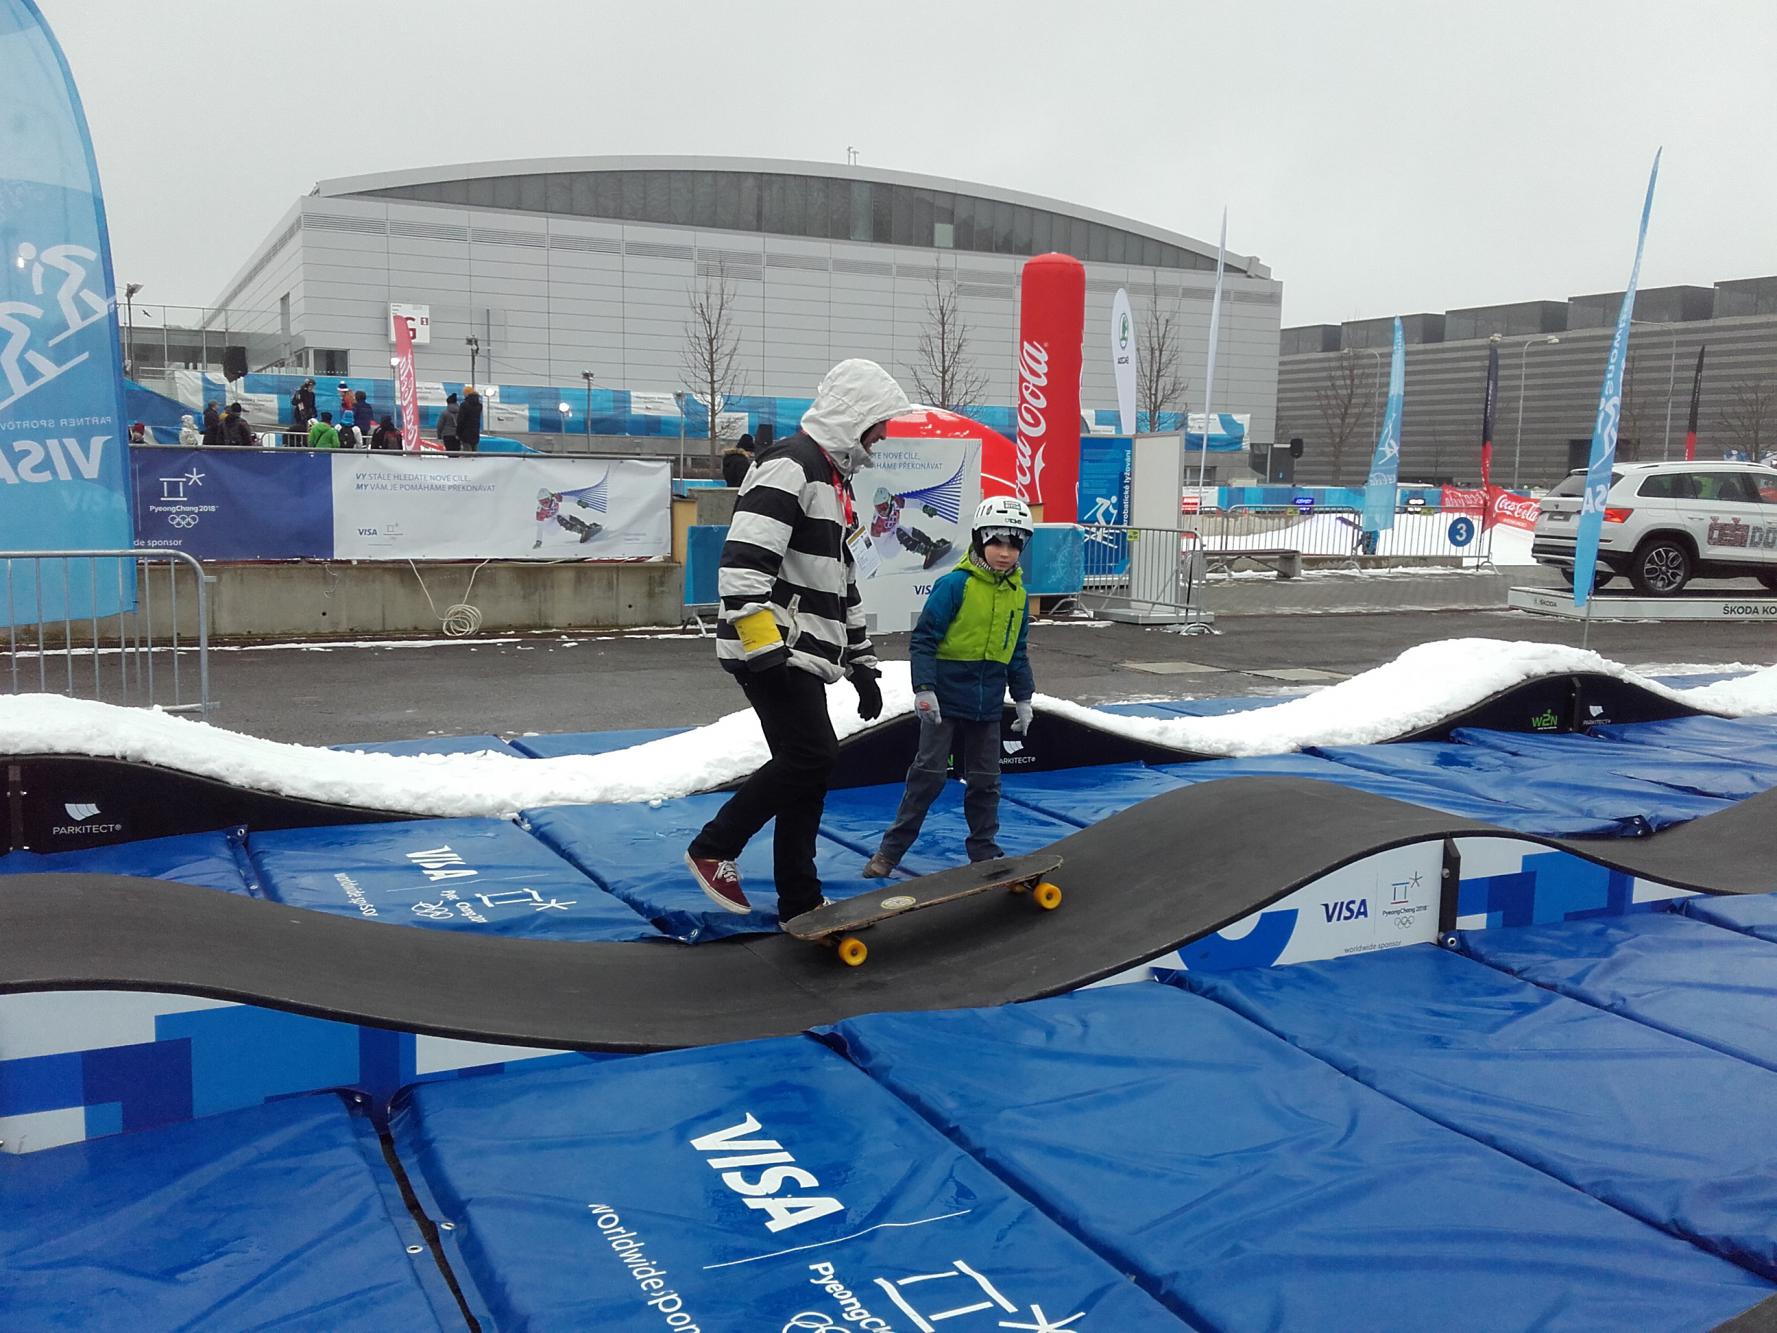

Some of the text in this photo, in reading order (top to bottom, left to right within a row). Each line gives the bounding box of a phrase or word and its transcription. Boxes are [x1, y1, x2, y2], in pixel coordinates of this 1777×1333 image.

[1016, 340, 1049, 503] oca-Cola
[355, 473, 366, 481] VY
[355, 483, 369, 491] MY
[149, 505, 199, 513] PyeongChang
[358, 528, 378, 536] VISA
[1455, 523, 1467, 541] 3
[147, 539, 182, 548] sponsor
[914, 584, 931, 596] VIS
[1723, 603, 1760, 615] ŠKODA
[1320, 898, 1369, 924] VISA
[689, 1112, 845, 1233] VISA
